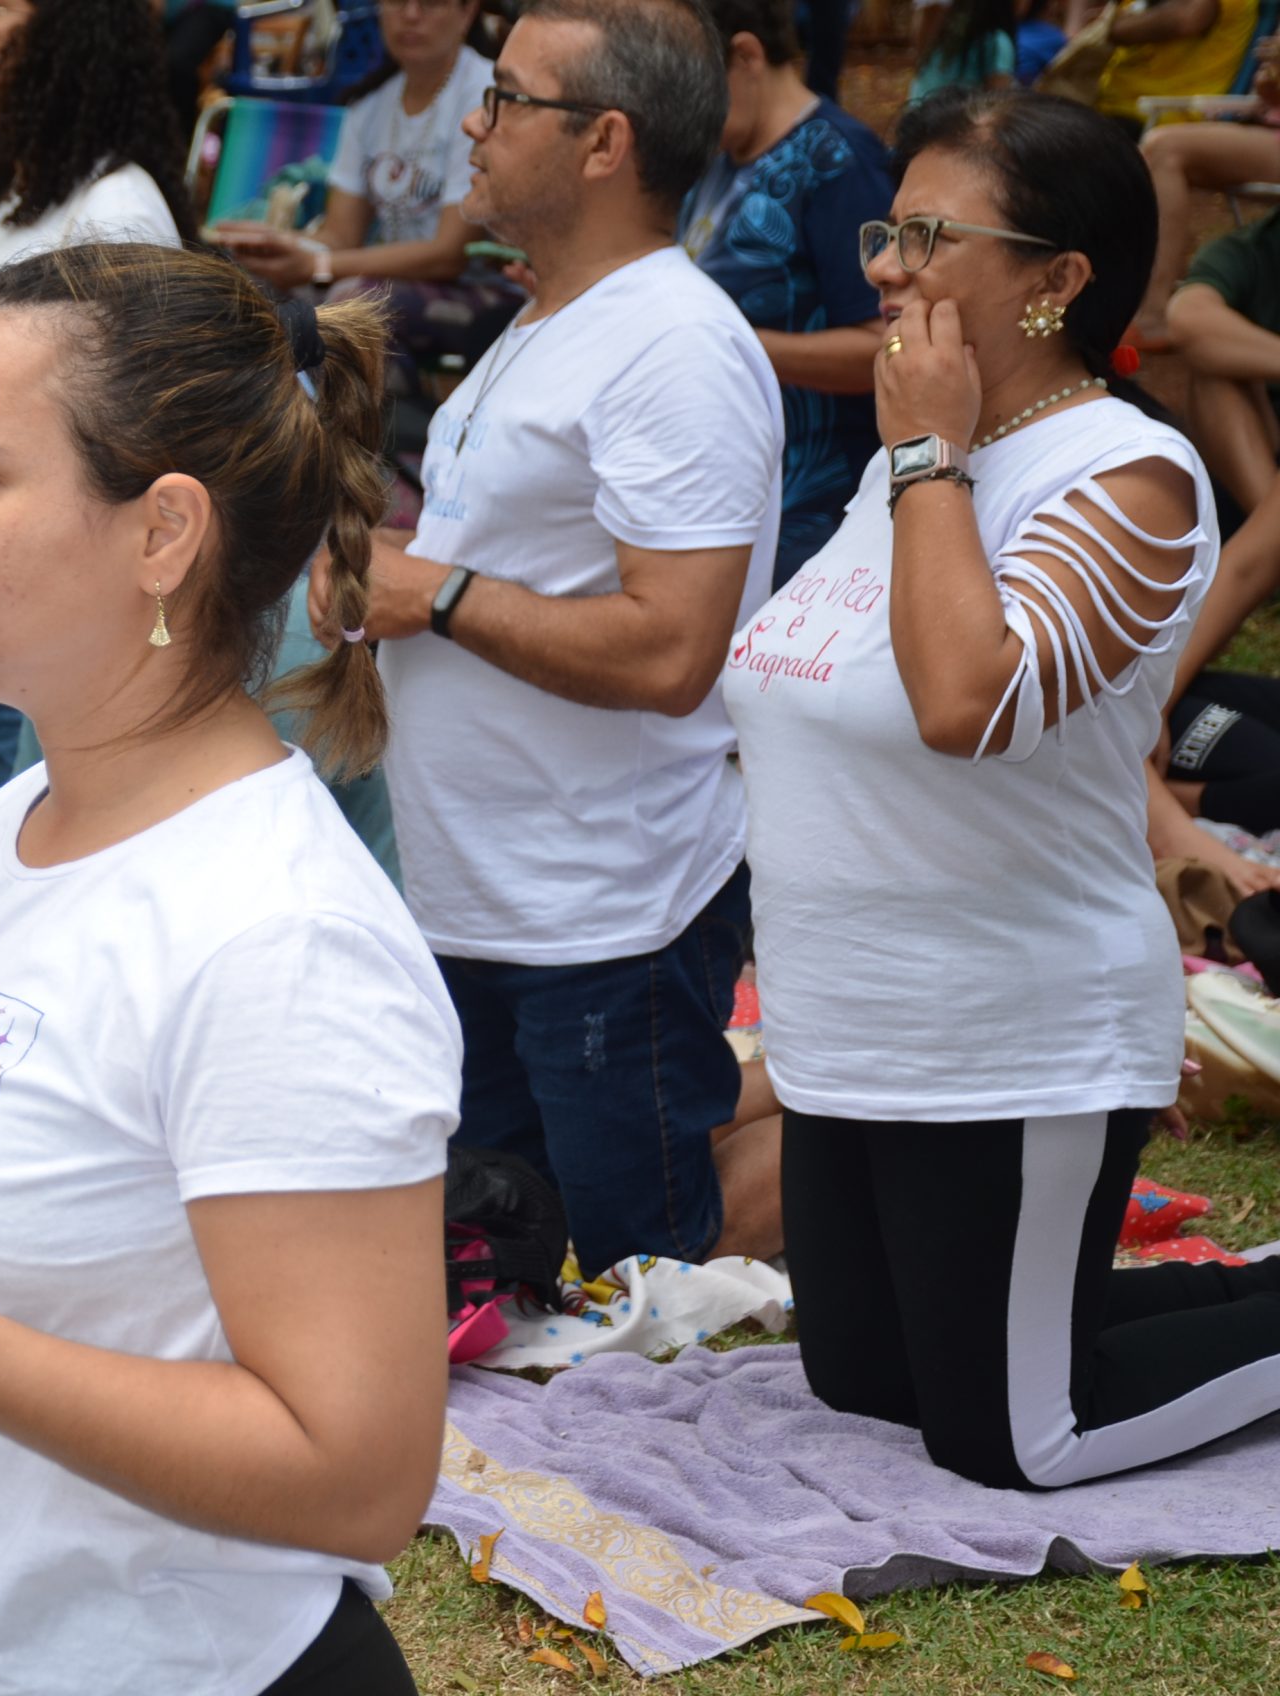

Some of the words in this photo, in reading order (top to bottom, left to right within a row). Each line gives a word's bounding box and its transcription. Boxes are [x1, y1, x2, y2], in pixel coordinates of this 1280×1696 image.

[826, 567, 884, 614] vida
[786, 605, 813, 638] é
[728, 616, 840, 692] Sagrada
